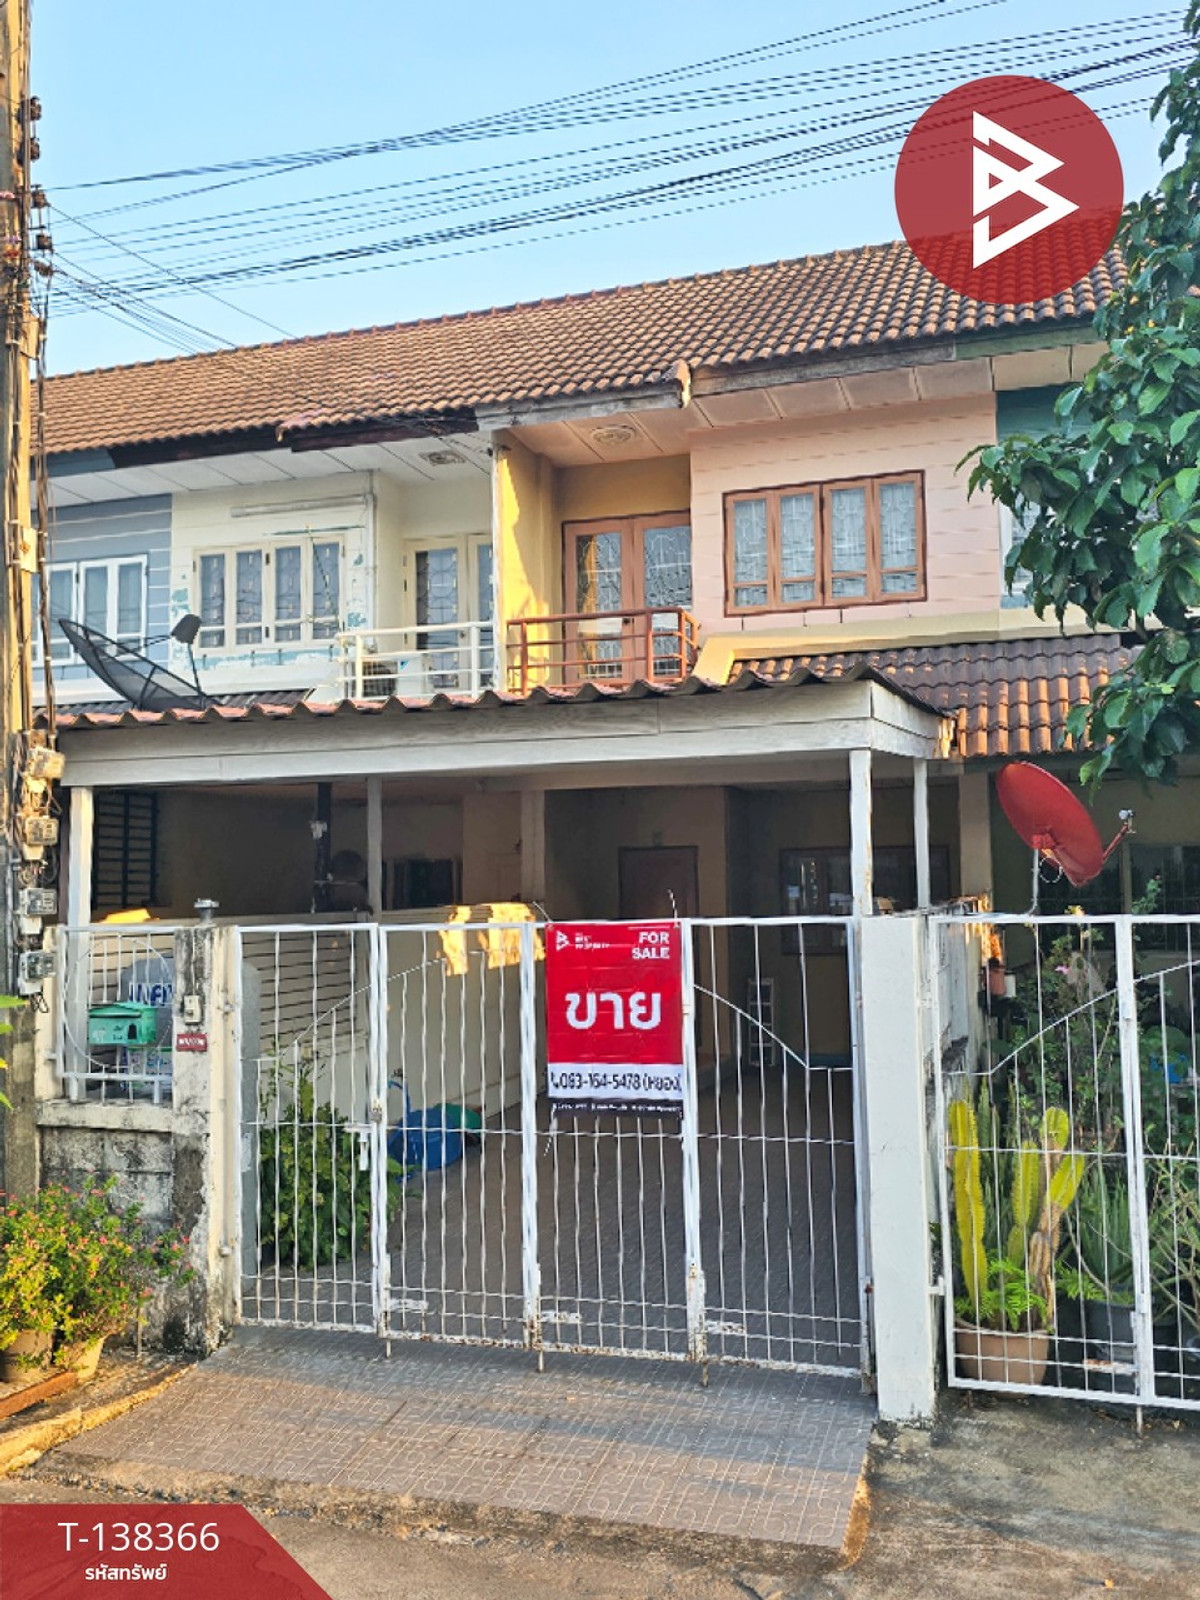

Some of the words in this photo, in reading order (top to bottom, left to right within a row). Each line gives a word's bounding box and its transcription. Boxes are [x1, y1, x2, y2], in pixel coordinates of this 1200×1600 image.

[639, 931, 669, 944] FOR
[632, 947, 670, 960] SALE
[565, 992, 662, 1030] ขาย
